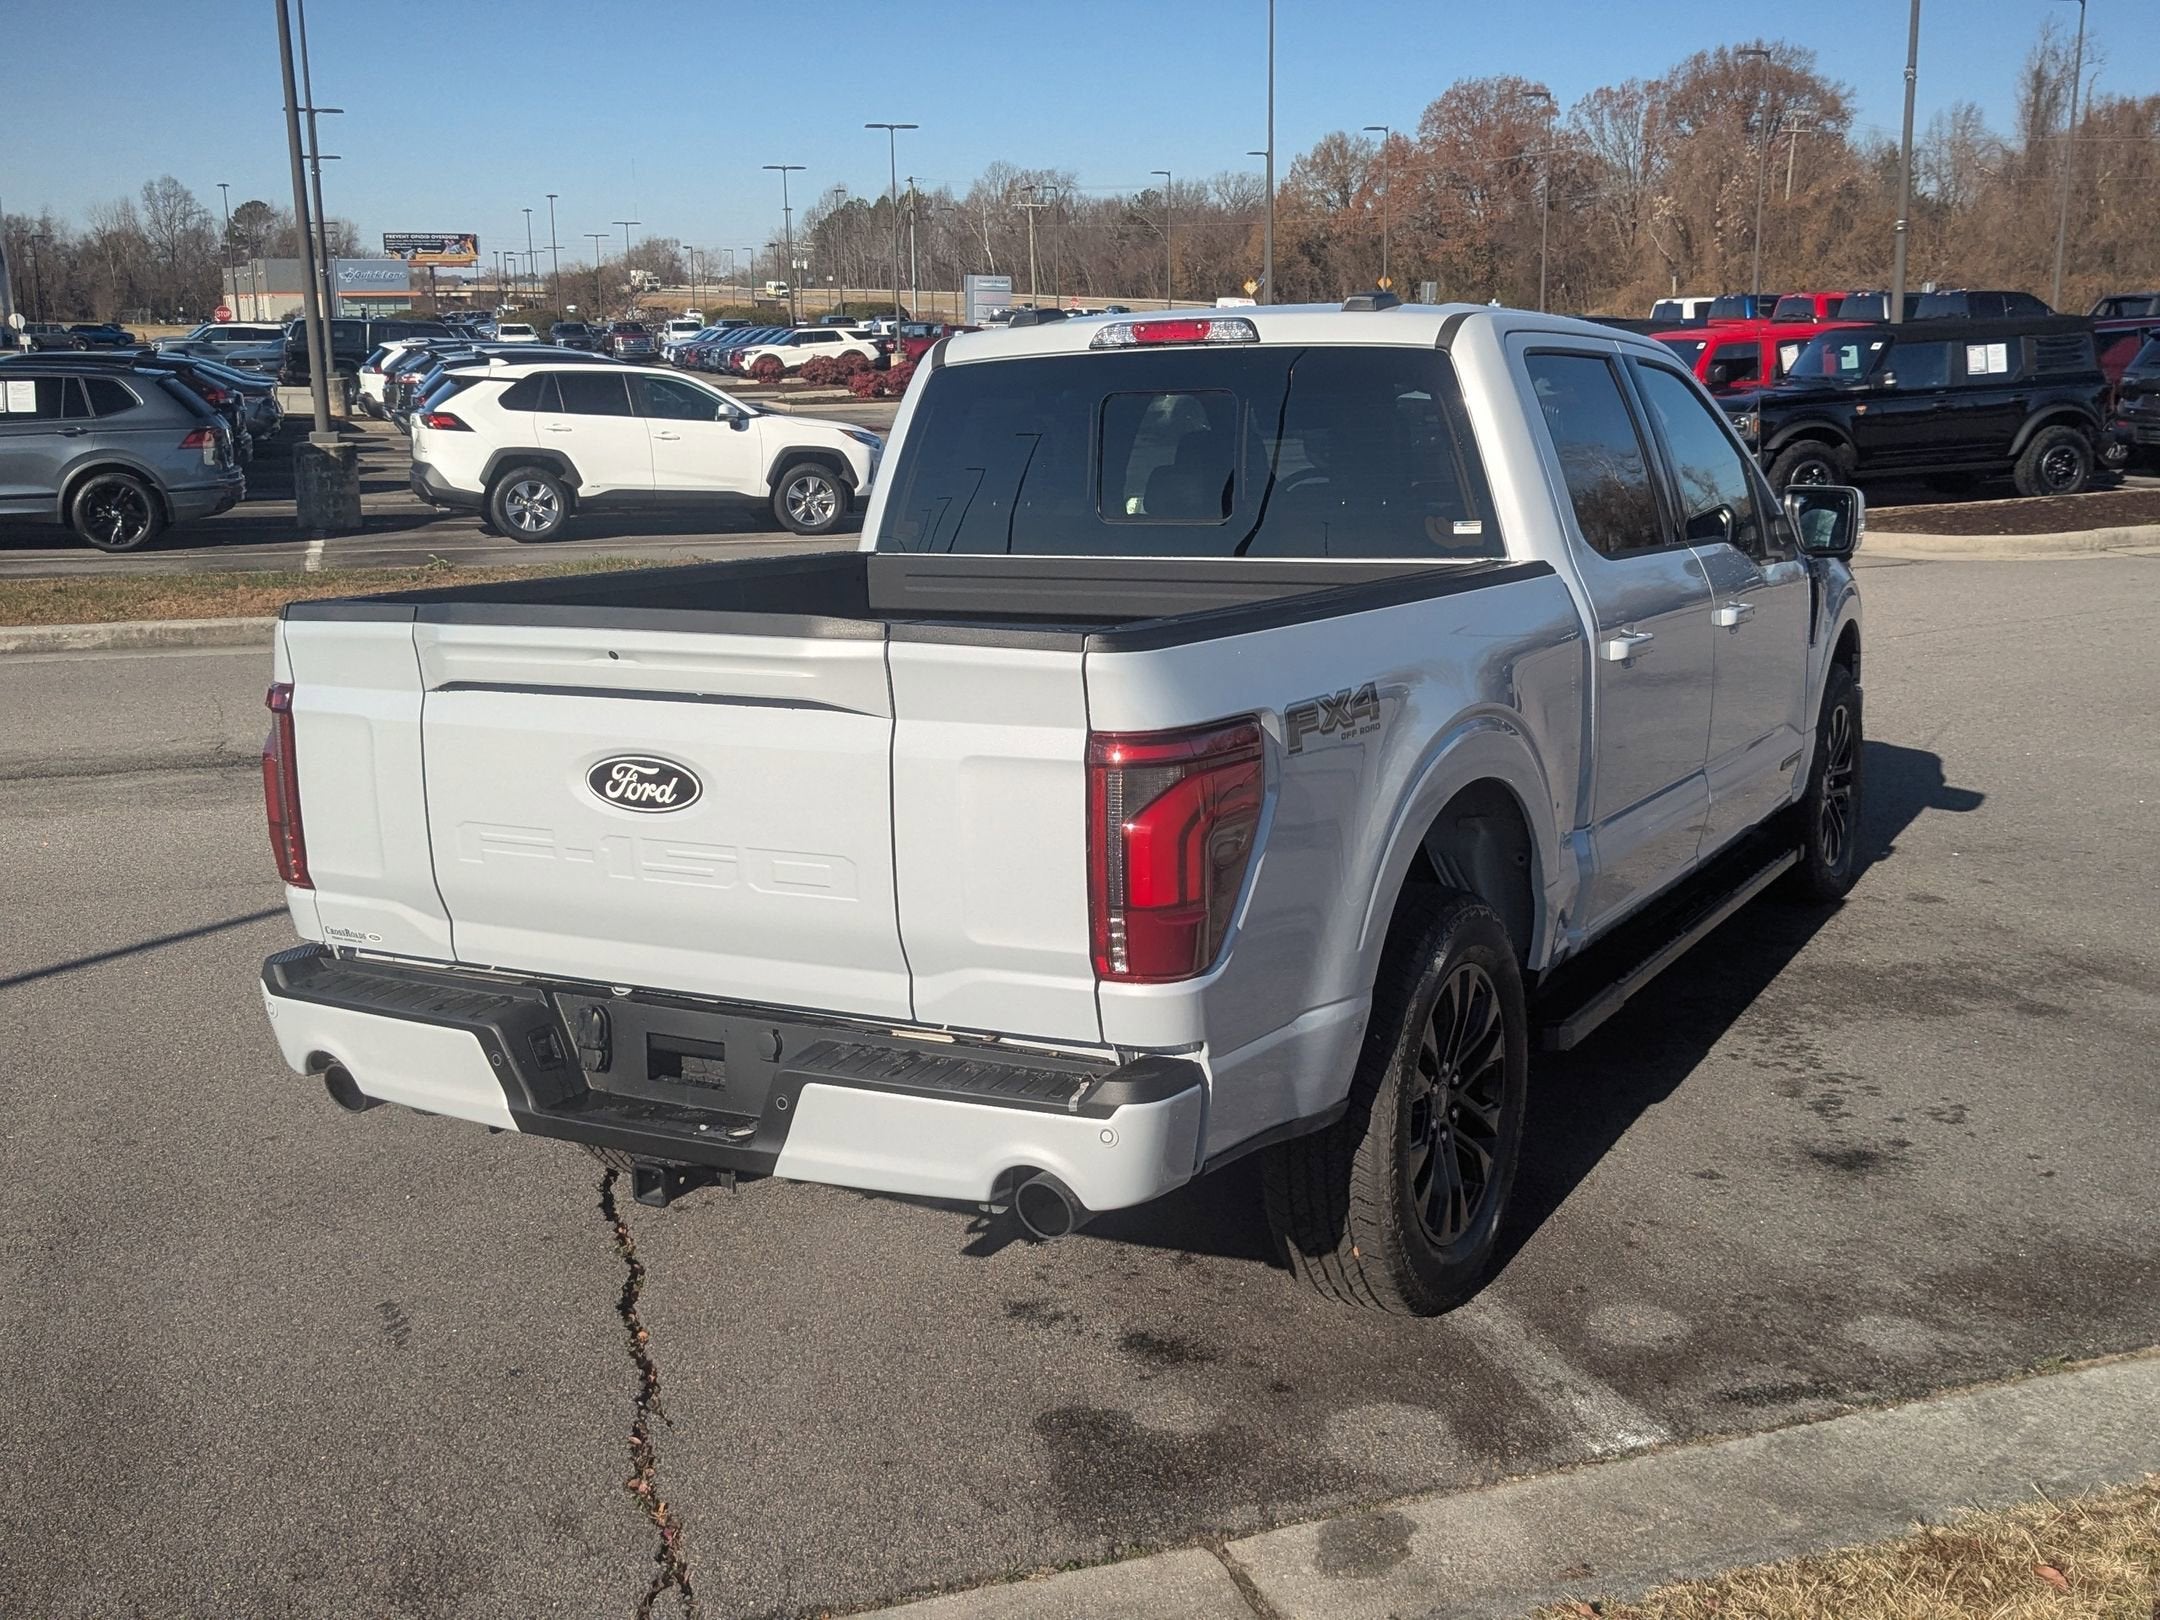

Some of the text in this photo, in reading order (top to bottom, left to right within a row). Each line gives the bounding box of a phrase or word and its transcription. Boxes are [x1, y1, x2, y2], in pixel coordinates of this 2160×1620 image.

[216, 310, 231, 318] STOP
[1284, 680, 1380, 755] FX4
[1341, 722, 1381, 740] OFF ROAD
[605, 763, 678, 804] Ford
[456, 820, 859, 902] F-150
